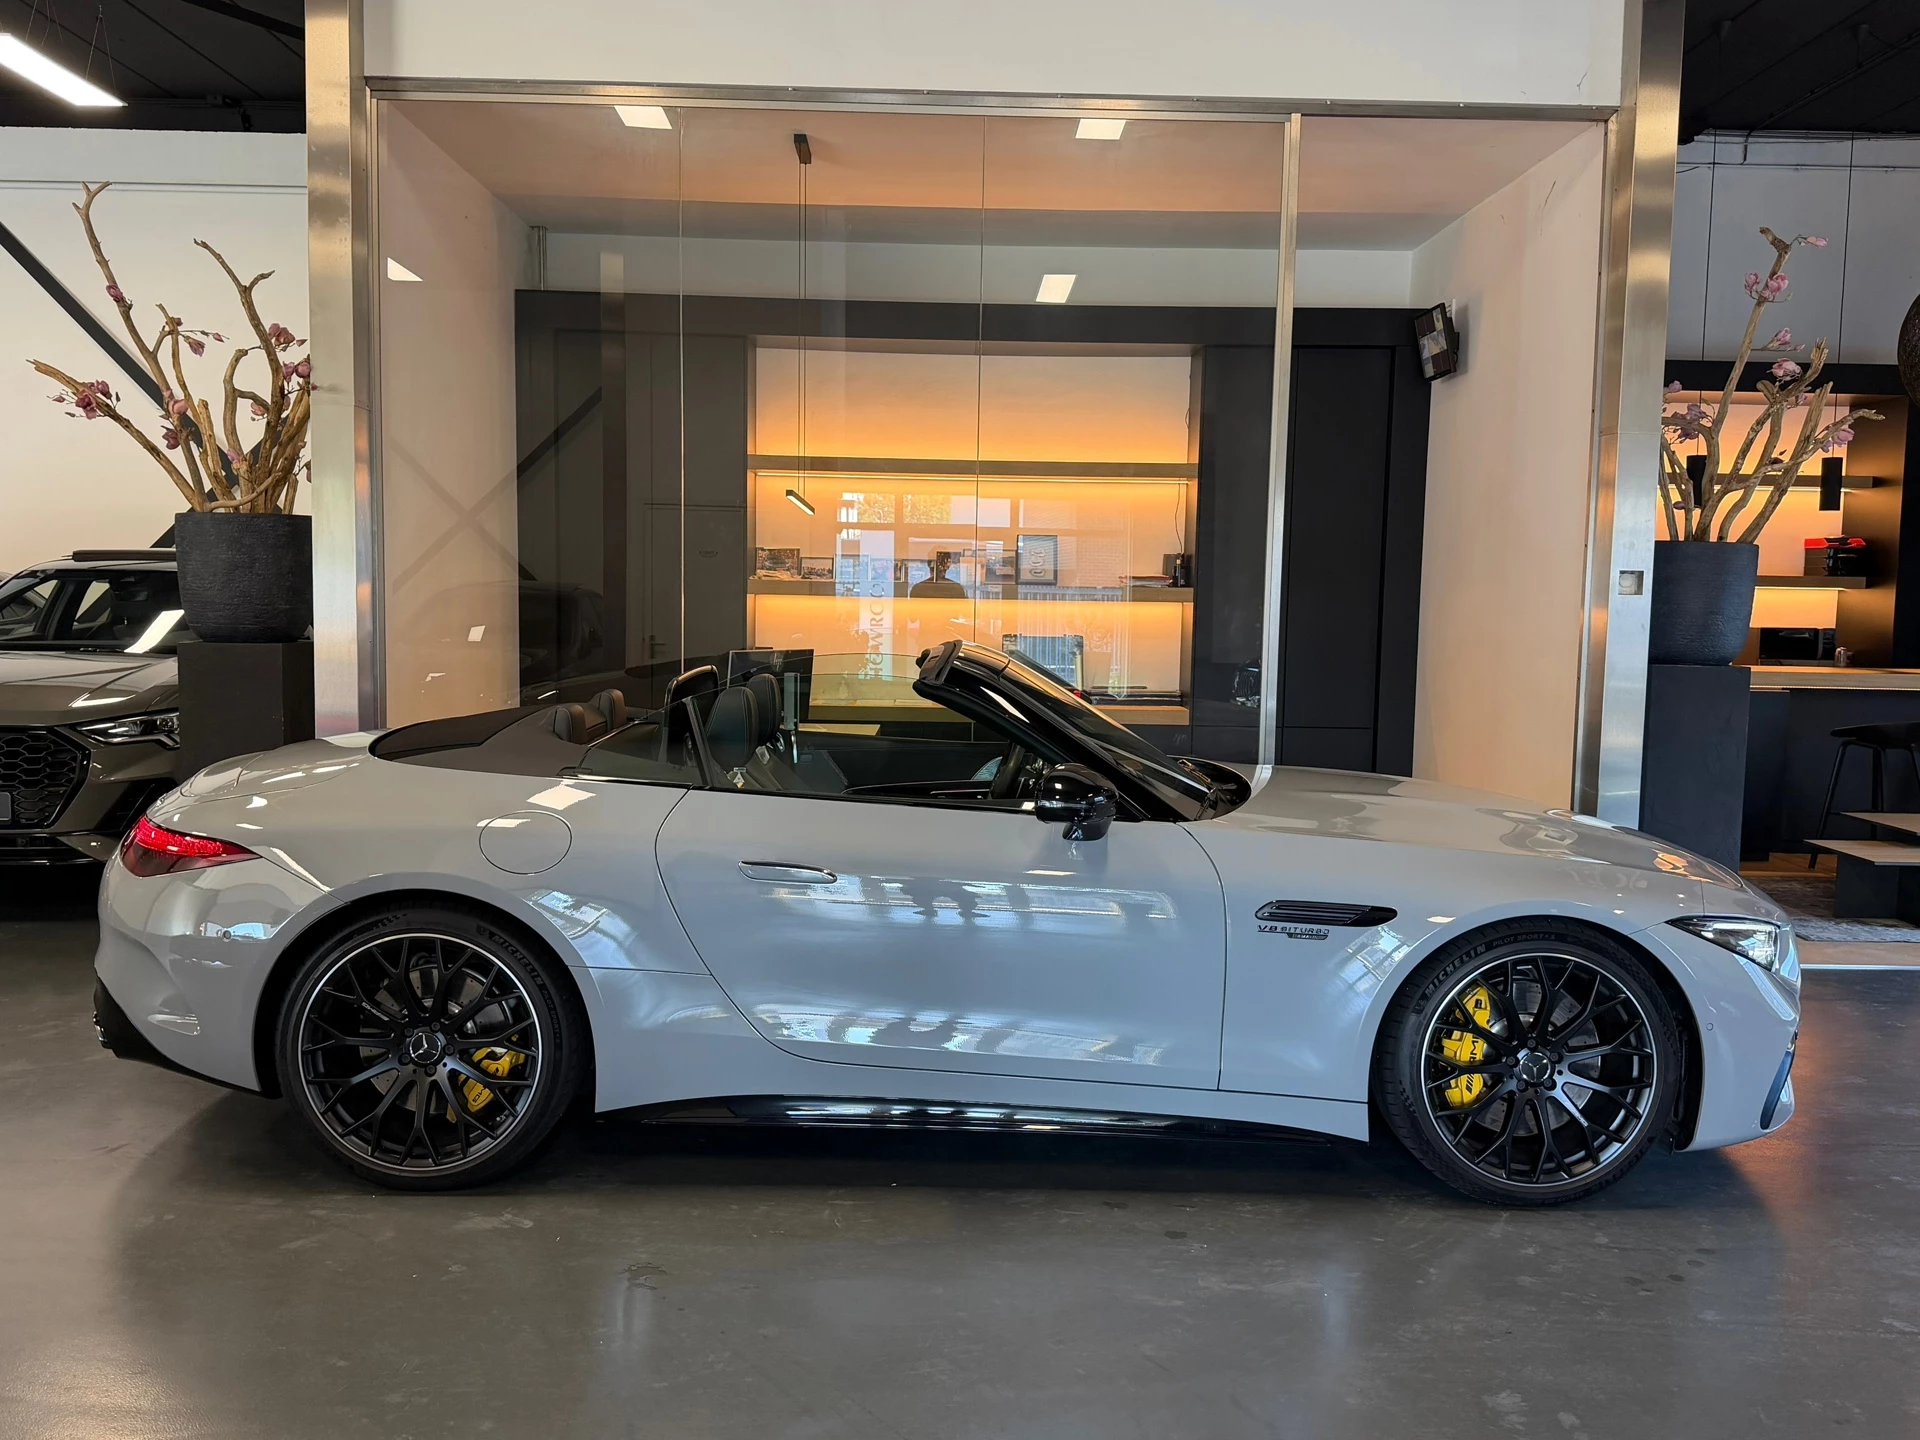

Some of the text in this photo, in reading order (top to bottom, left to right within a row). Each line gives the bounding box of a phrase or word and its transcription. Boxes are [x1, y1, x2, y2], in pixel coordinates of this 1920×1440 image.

[1280, 926, 1330, 935] BITURBO
[491, 935, 544, 985] MICHELIN
[1425, 943, 1486, 998] MICHELIN
[1492, 936, 1515, 947] PILOT
[1517, 933, 1545, 941] SPORT
